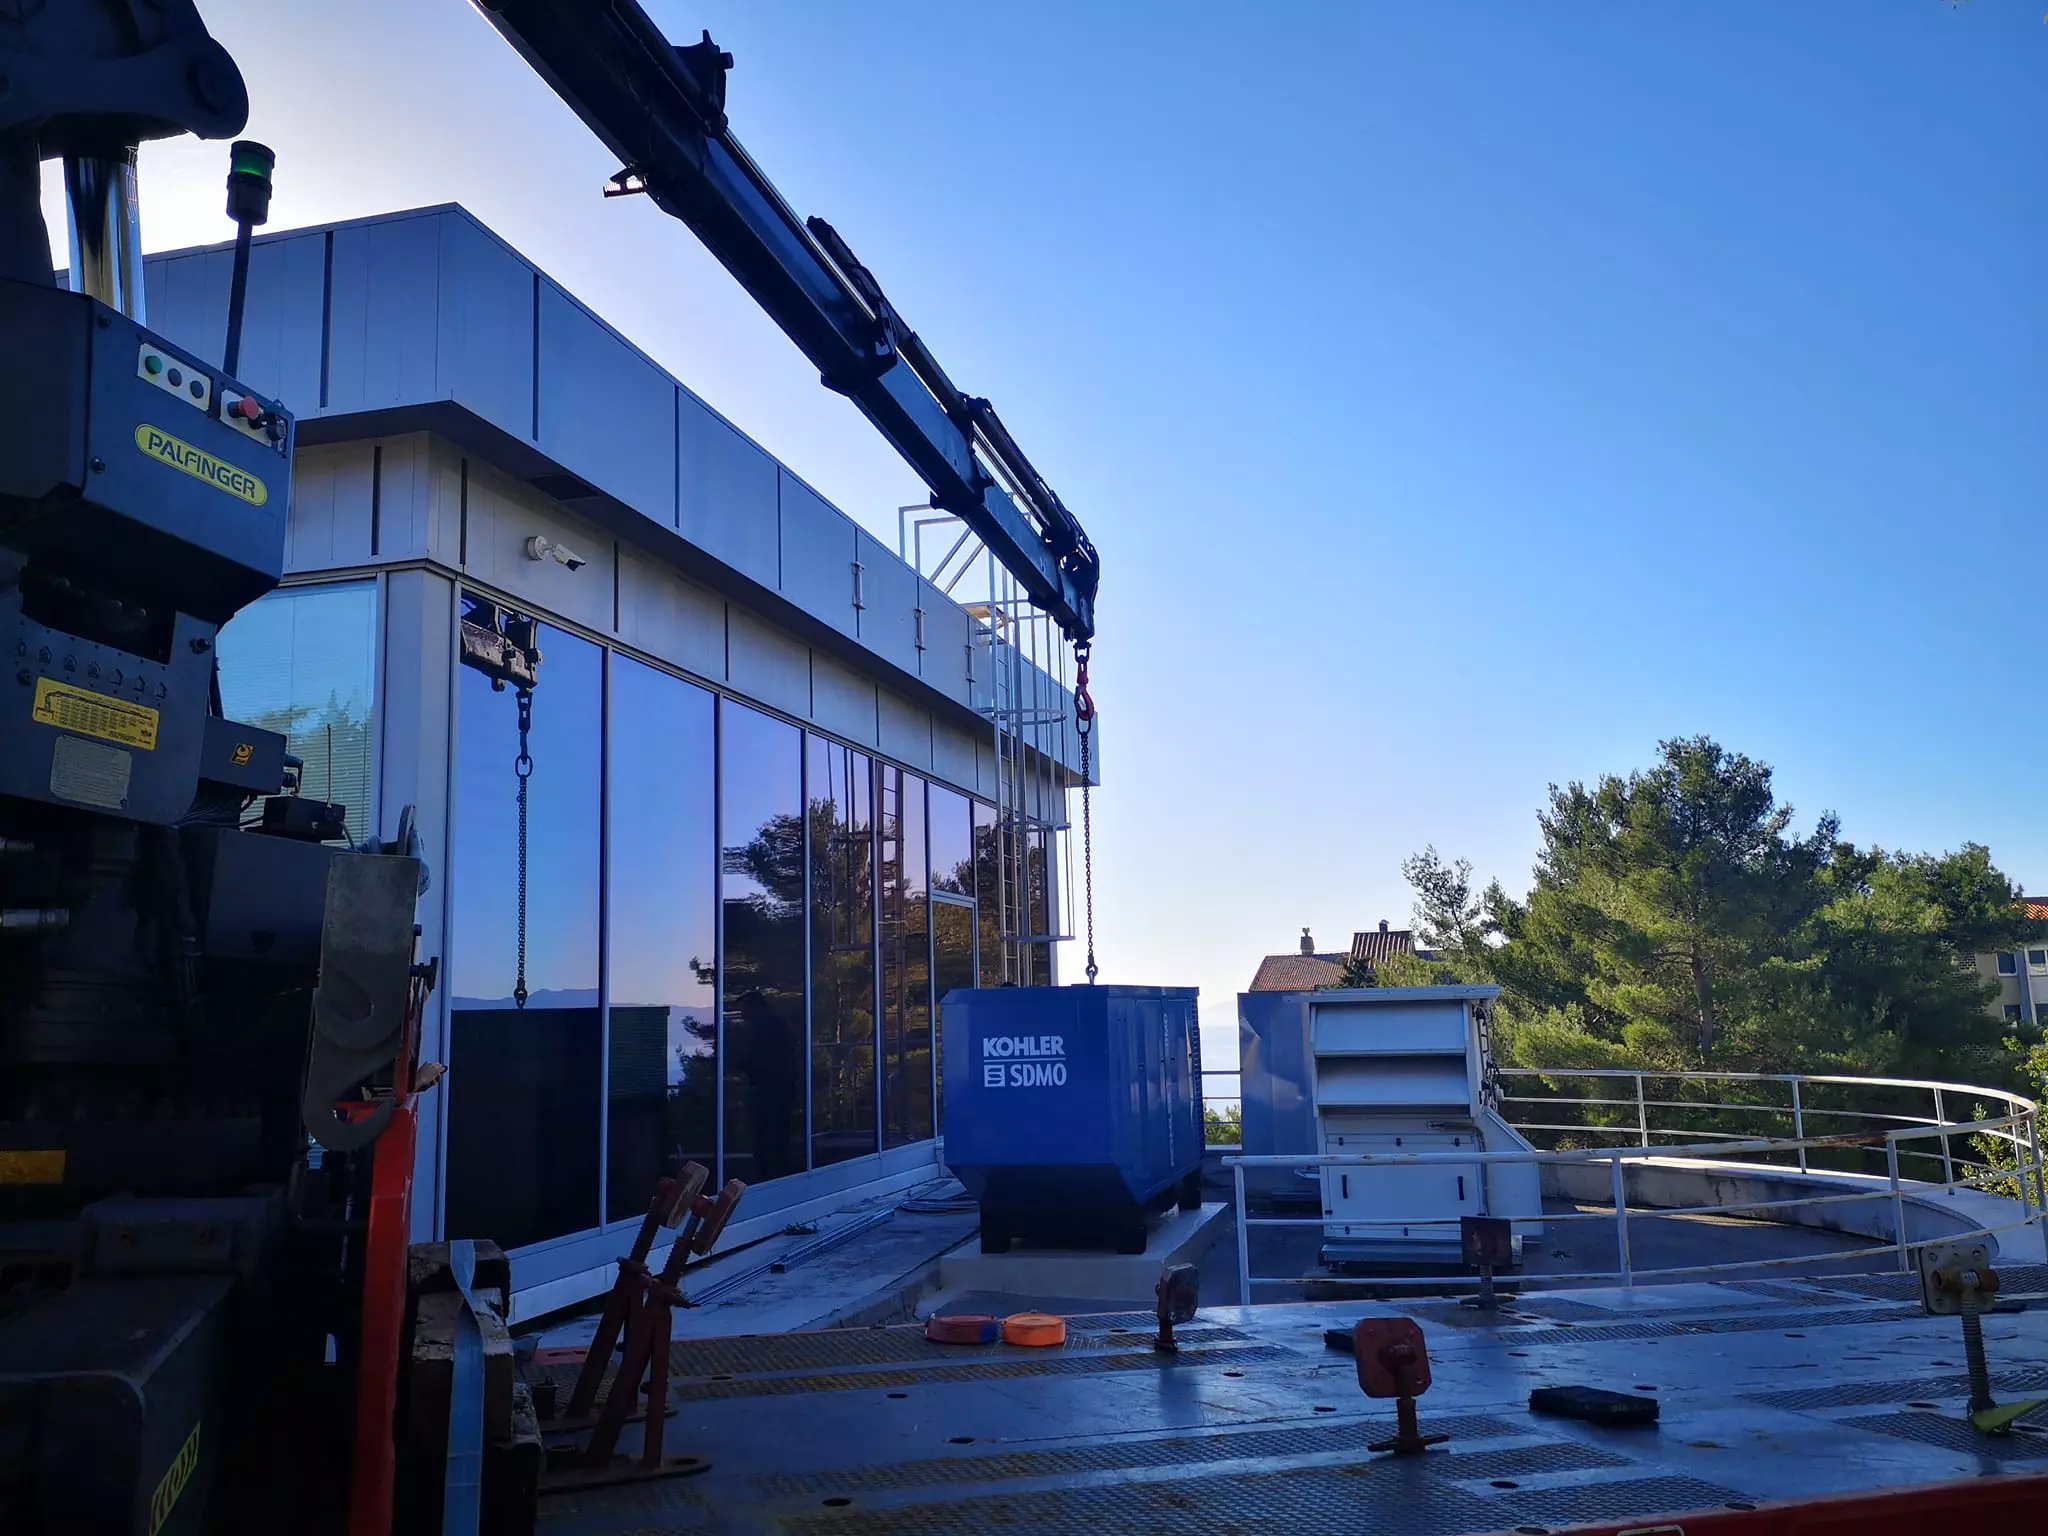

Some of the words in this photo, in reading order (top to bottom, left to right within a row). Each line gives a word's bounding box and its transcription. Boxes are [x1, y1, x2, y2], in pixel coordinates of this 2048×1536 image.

[148, 431, 256, 499] PALFINGER
[983, 1035, 1066, 1057] KOHLER
[1010, 1063, 1067, 1087] SDMO
